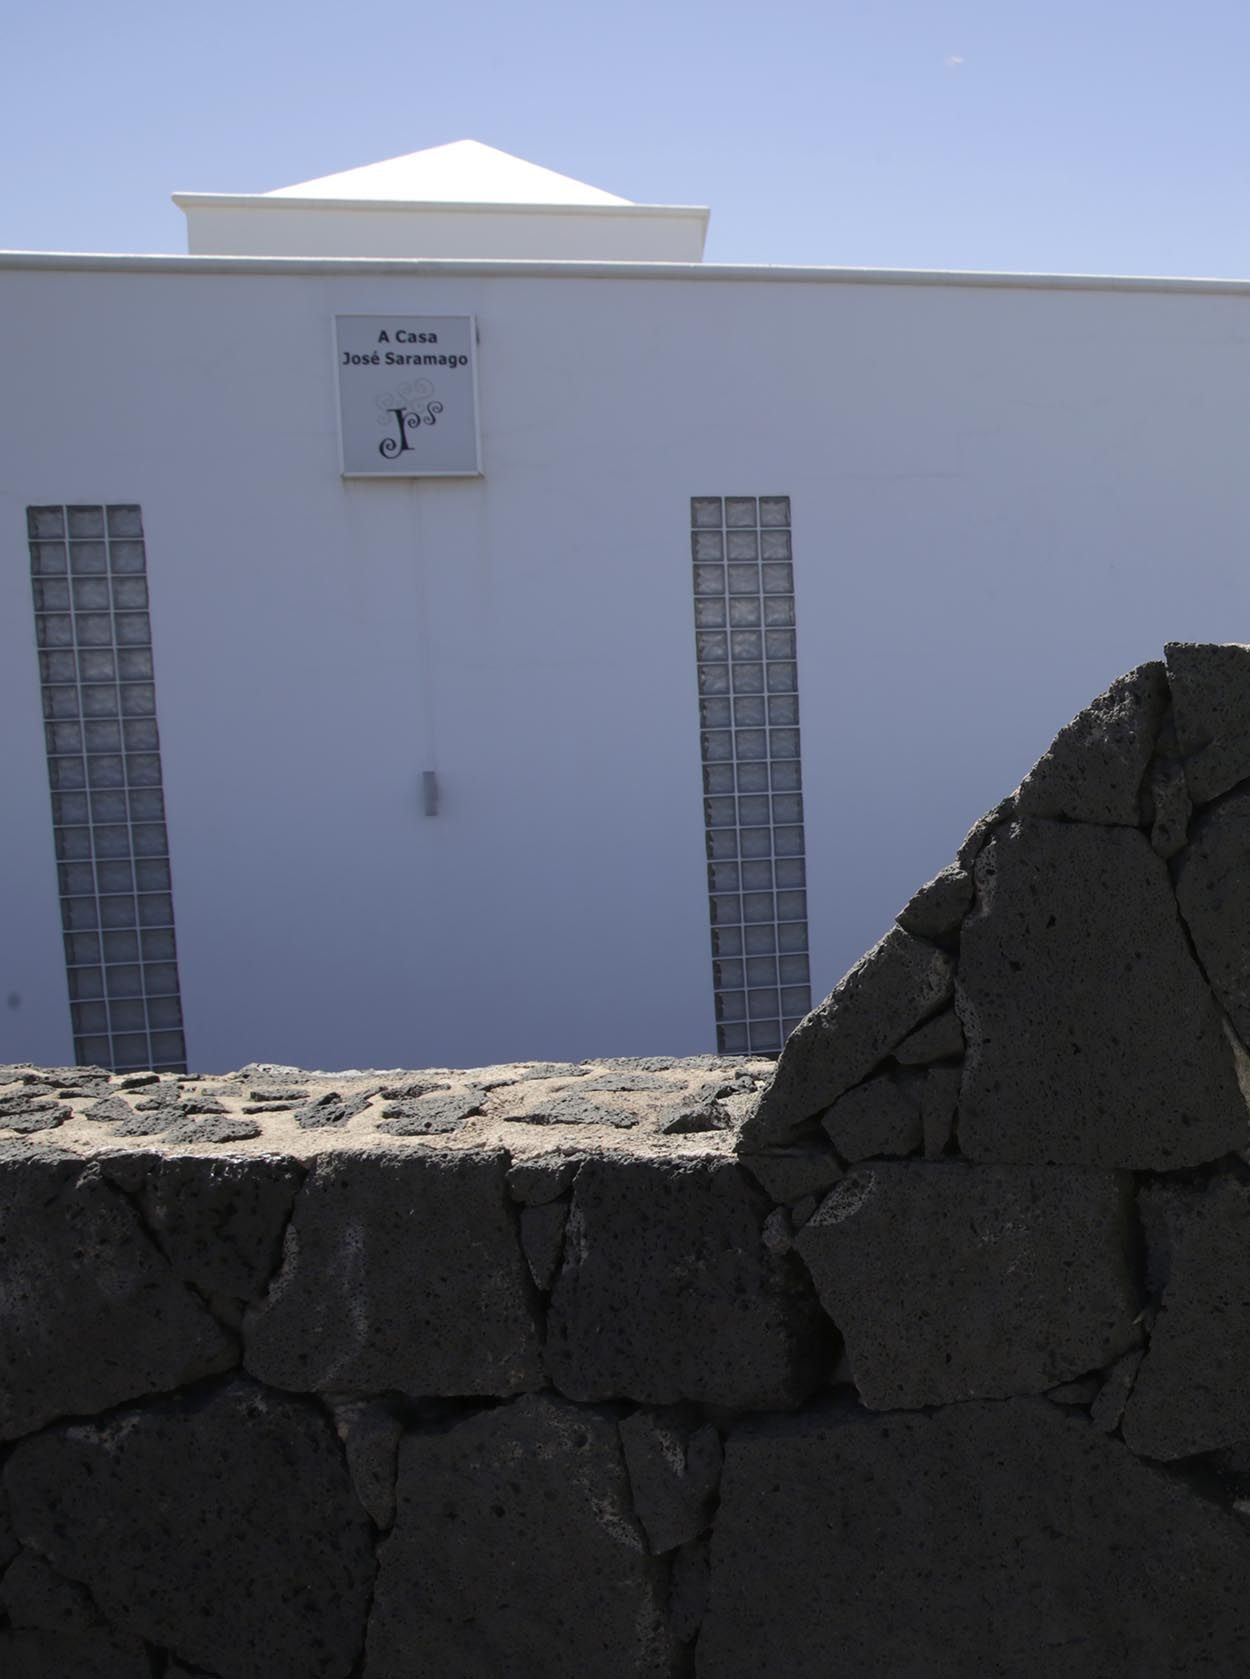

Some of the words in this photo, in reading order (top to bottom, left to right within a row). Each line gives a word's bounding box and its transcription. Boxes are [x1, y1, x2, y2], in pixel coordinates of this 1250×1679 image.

[378, 330, 390, 343] A
[395, 330, 438, 343] Casa
[342, 350, 380, 366] José
[385, 352, 468, 368] Saramago
